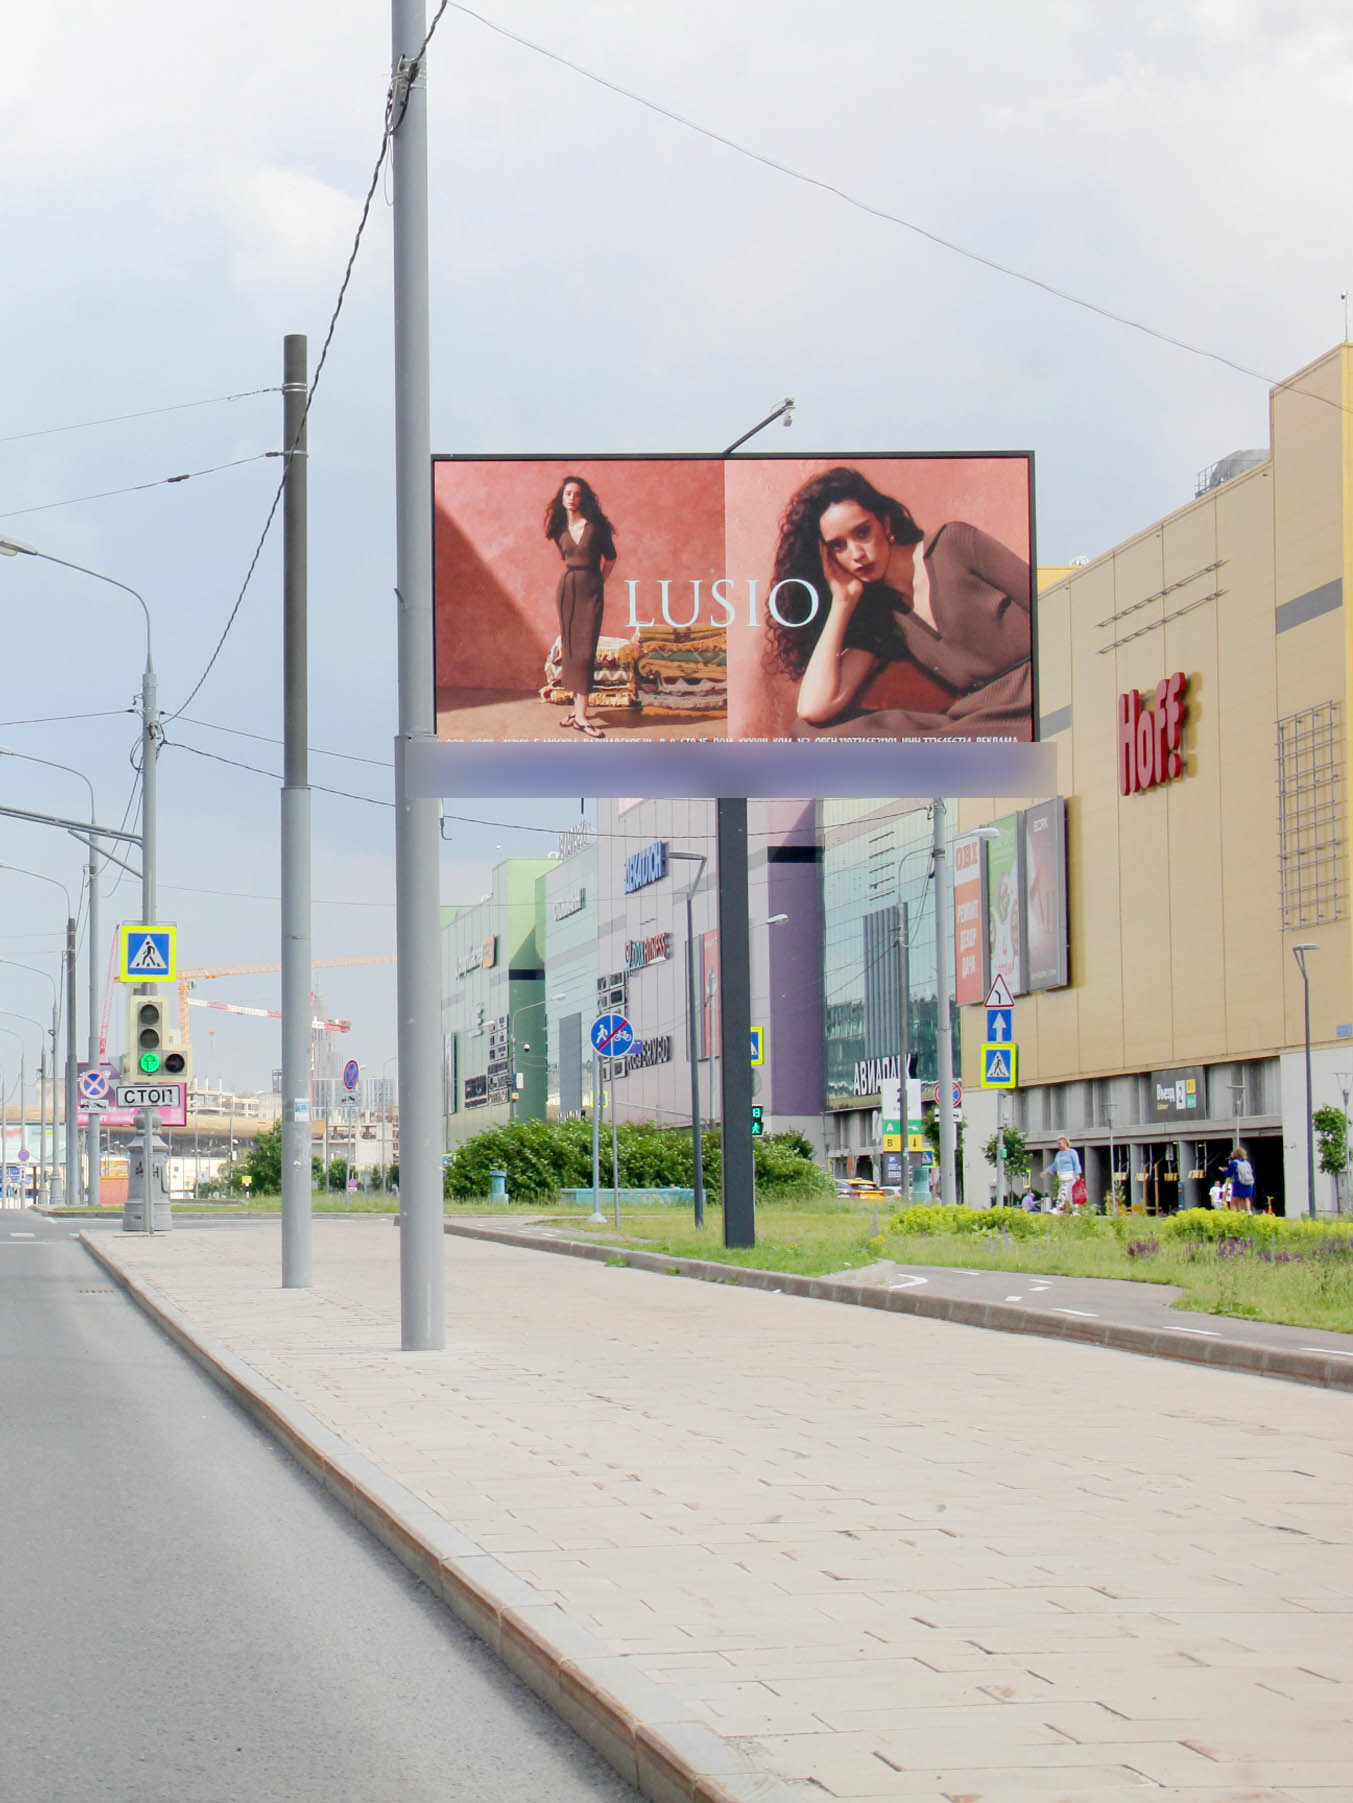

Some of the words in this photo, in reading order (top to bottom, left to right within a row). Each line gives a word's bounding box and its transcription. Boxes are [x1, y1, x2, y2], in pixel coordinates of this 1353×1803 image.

[624, 578, 820, 628] LUSIO
[1119, 671, 1186, 796] Hoff
[124, 1089, 173, 1103] СТОП
[853, 1053, 912, 1097] АВИАПАК
